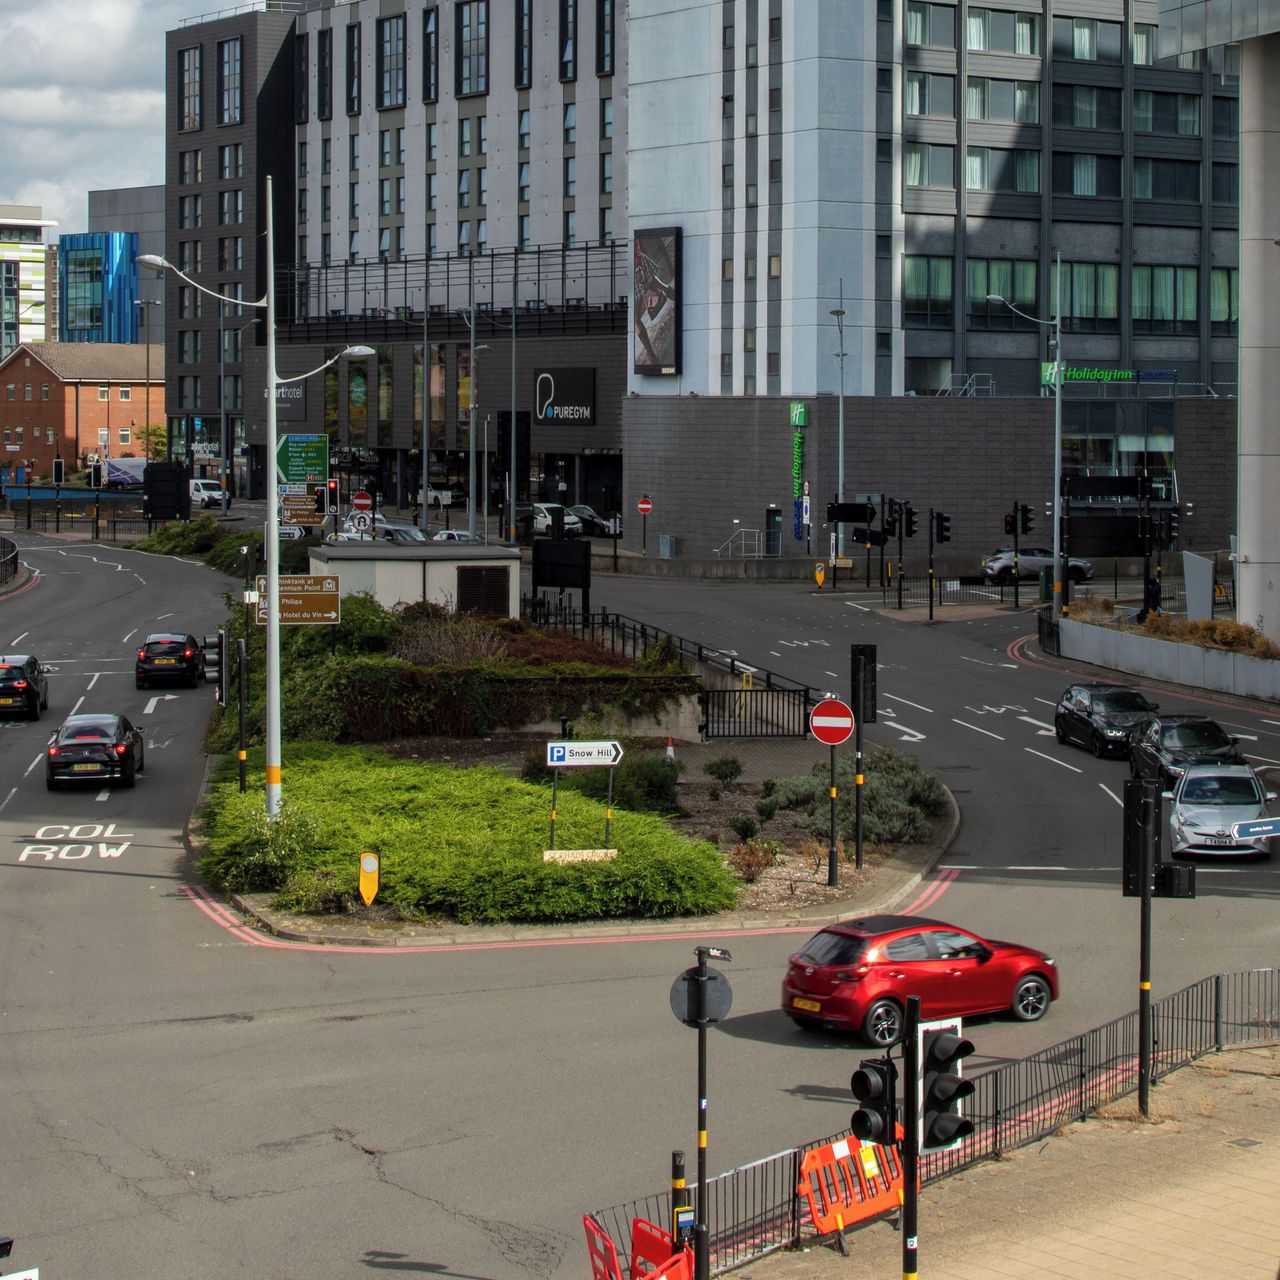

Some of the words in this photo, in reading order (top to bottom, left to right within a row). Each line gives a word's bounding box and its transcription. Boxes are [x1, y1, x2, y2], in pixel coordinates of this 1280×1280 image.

[554, 406, 590, 419] PUREGYM
[569, 749, 593, 757] Snow
[597, 748, 612, 757] Hill
[34, 824, 135, 841] COL
[18, 841, 132, 862] ROW
